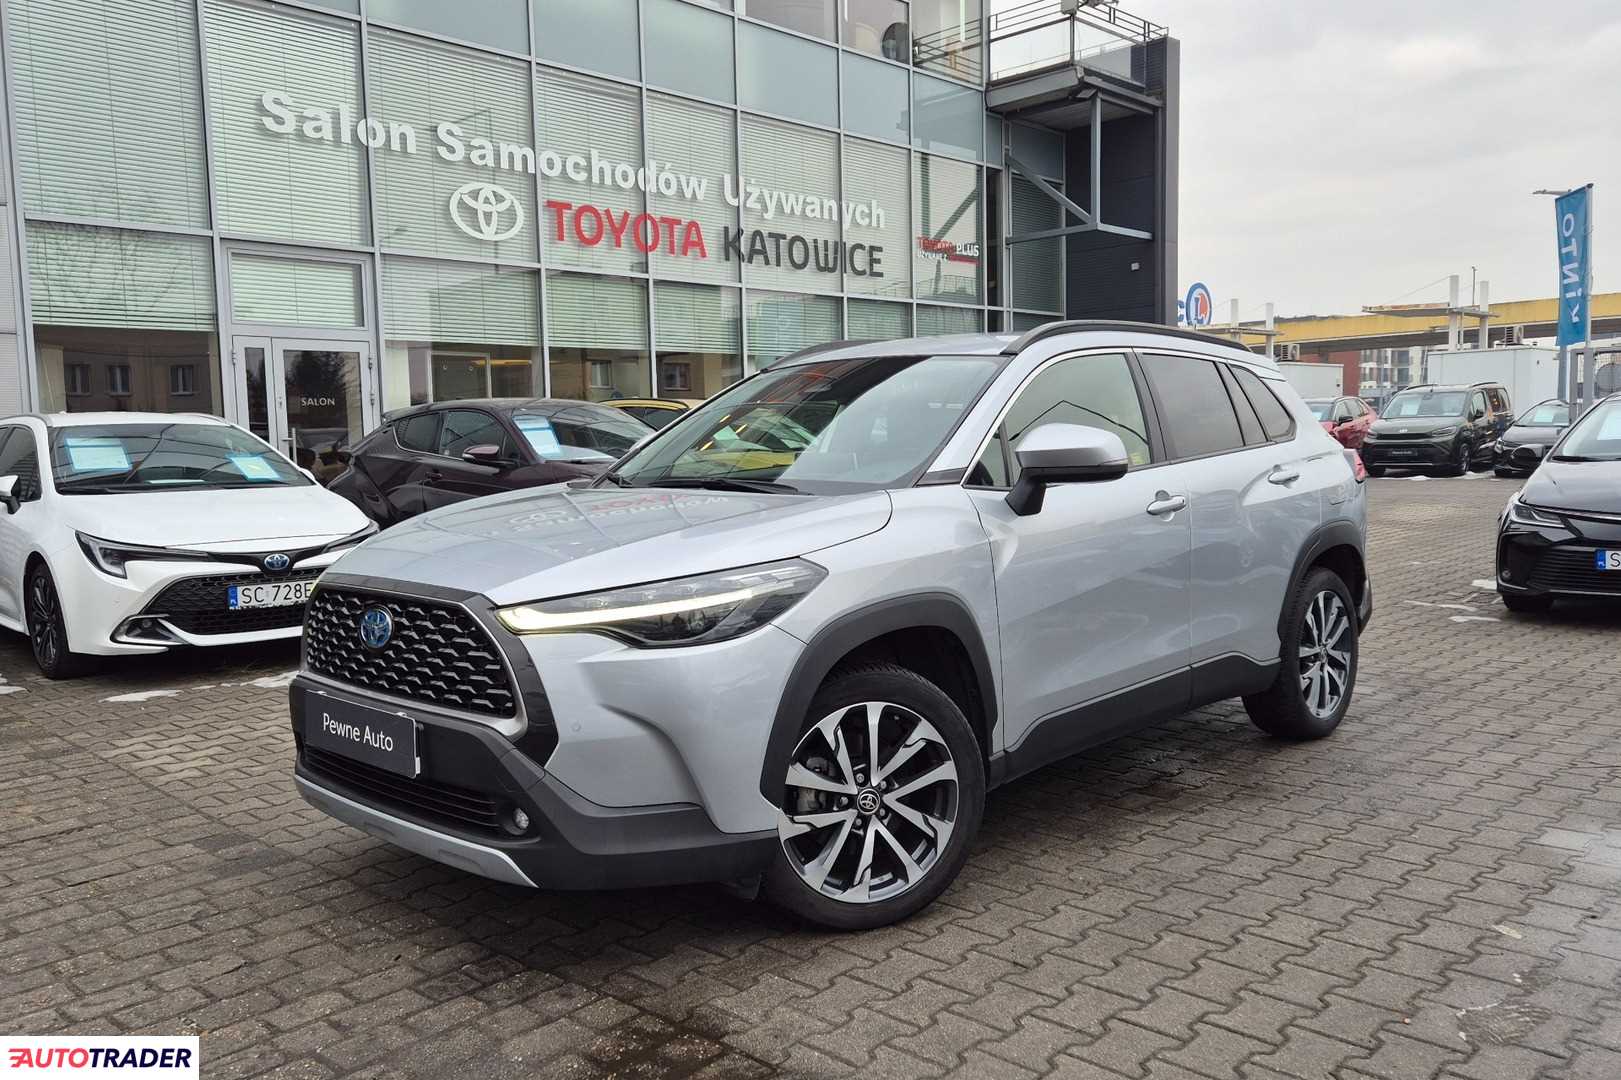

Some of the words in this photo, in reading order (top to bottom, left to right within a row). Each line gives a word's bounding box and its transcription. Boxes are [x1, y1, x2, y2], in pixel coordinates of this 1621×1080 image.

[261, 91, 417, 154] Salon
[436, 122, 708, 200] Samochodów
[723, 173, 886, 230] Używanych
[545, 200, 708, 259] TOYOTA
[723, 225, 885, 278] KATOWICE
[955, 242, 980, 257] PLUS
[301, 397, 336, 407] SALON
[241, 586, 264, 604] SC
[323, 712, 361, 742] Pewne
[362, 725, 394, 752] Auto
